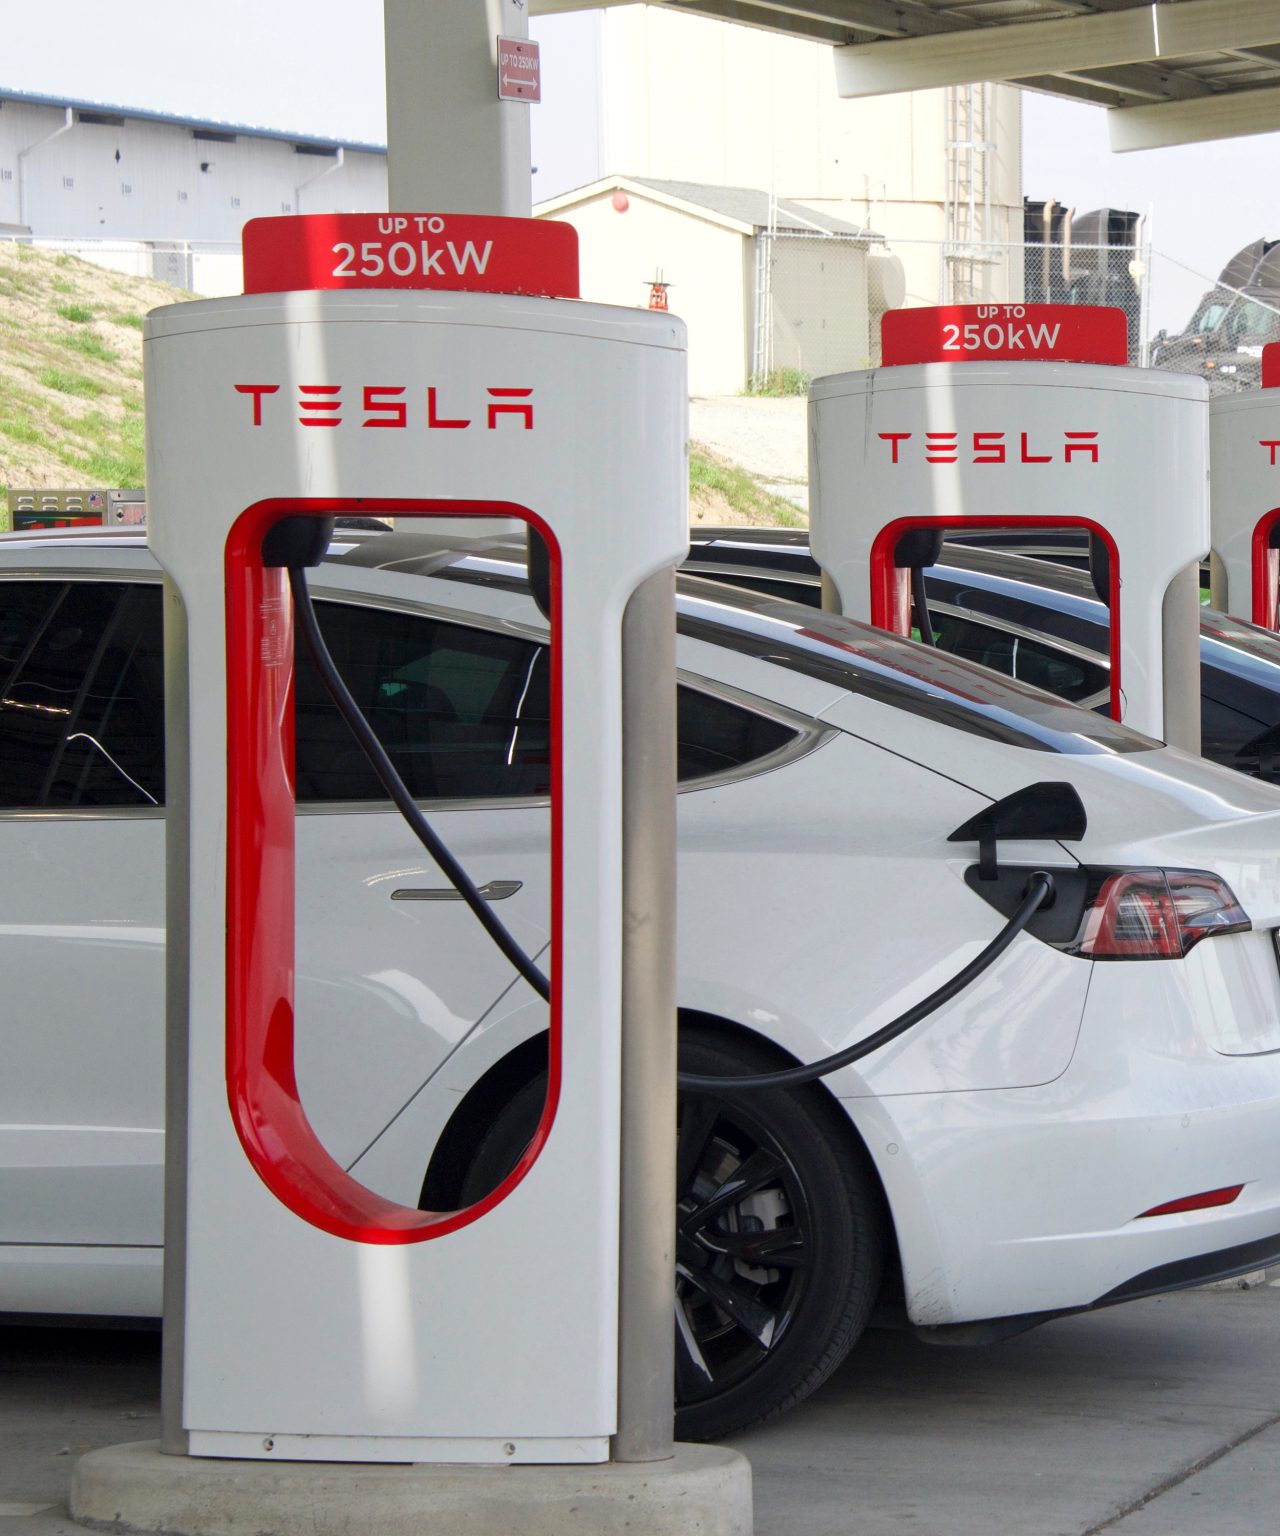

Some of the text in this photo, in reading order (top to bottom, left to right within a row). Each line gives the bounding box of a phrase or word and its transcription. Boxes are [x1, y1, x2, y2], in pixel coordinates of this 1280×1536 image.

[378, 216, 445, 234] UP TO
[332, 240, 493, 277] 250kW
[977, 306, 1026, 319] UP TO
[942, 323, 1061, 351] 250kW
[234, 385, 534, 430] TESLA
[878, 431, 1099, 464] TESLA
